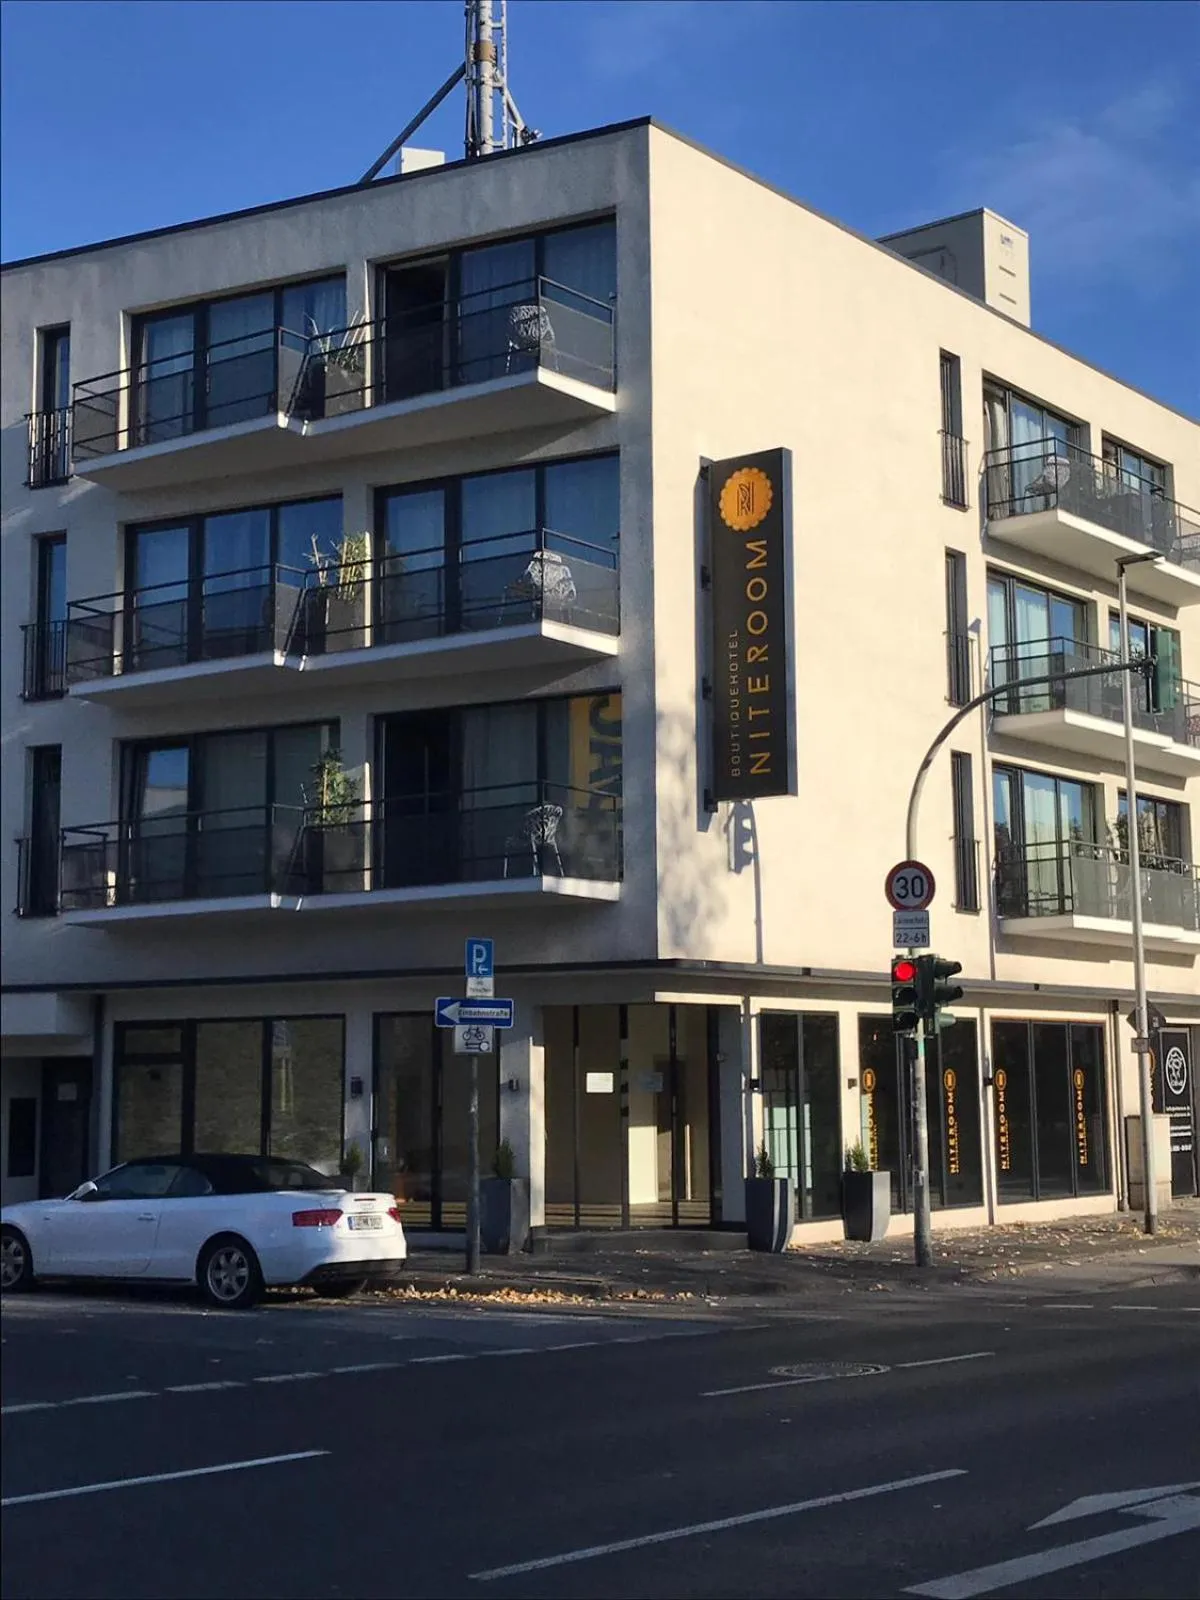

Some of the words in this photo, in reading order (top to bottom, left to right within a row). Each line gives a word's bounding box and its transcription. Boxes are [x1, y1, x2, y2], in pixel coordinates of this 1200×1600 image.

[746, 539, 771, 775] NITEROOM
[729, 629, 740, 777] BOUTIQUEHOTEL
[895, 876, 924, 899] 30
[472, 944, 487, 973] P
[947, 1092, 957, 1173] NITEROOM
